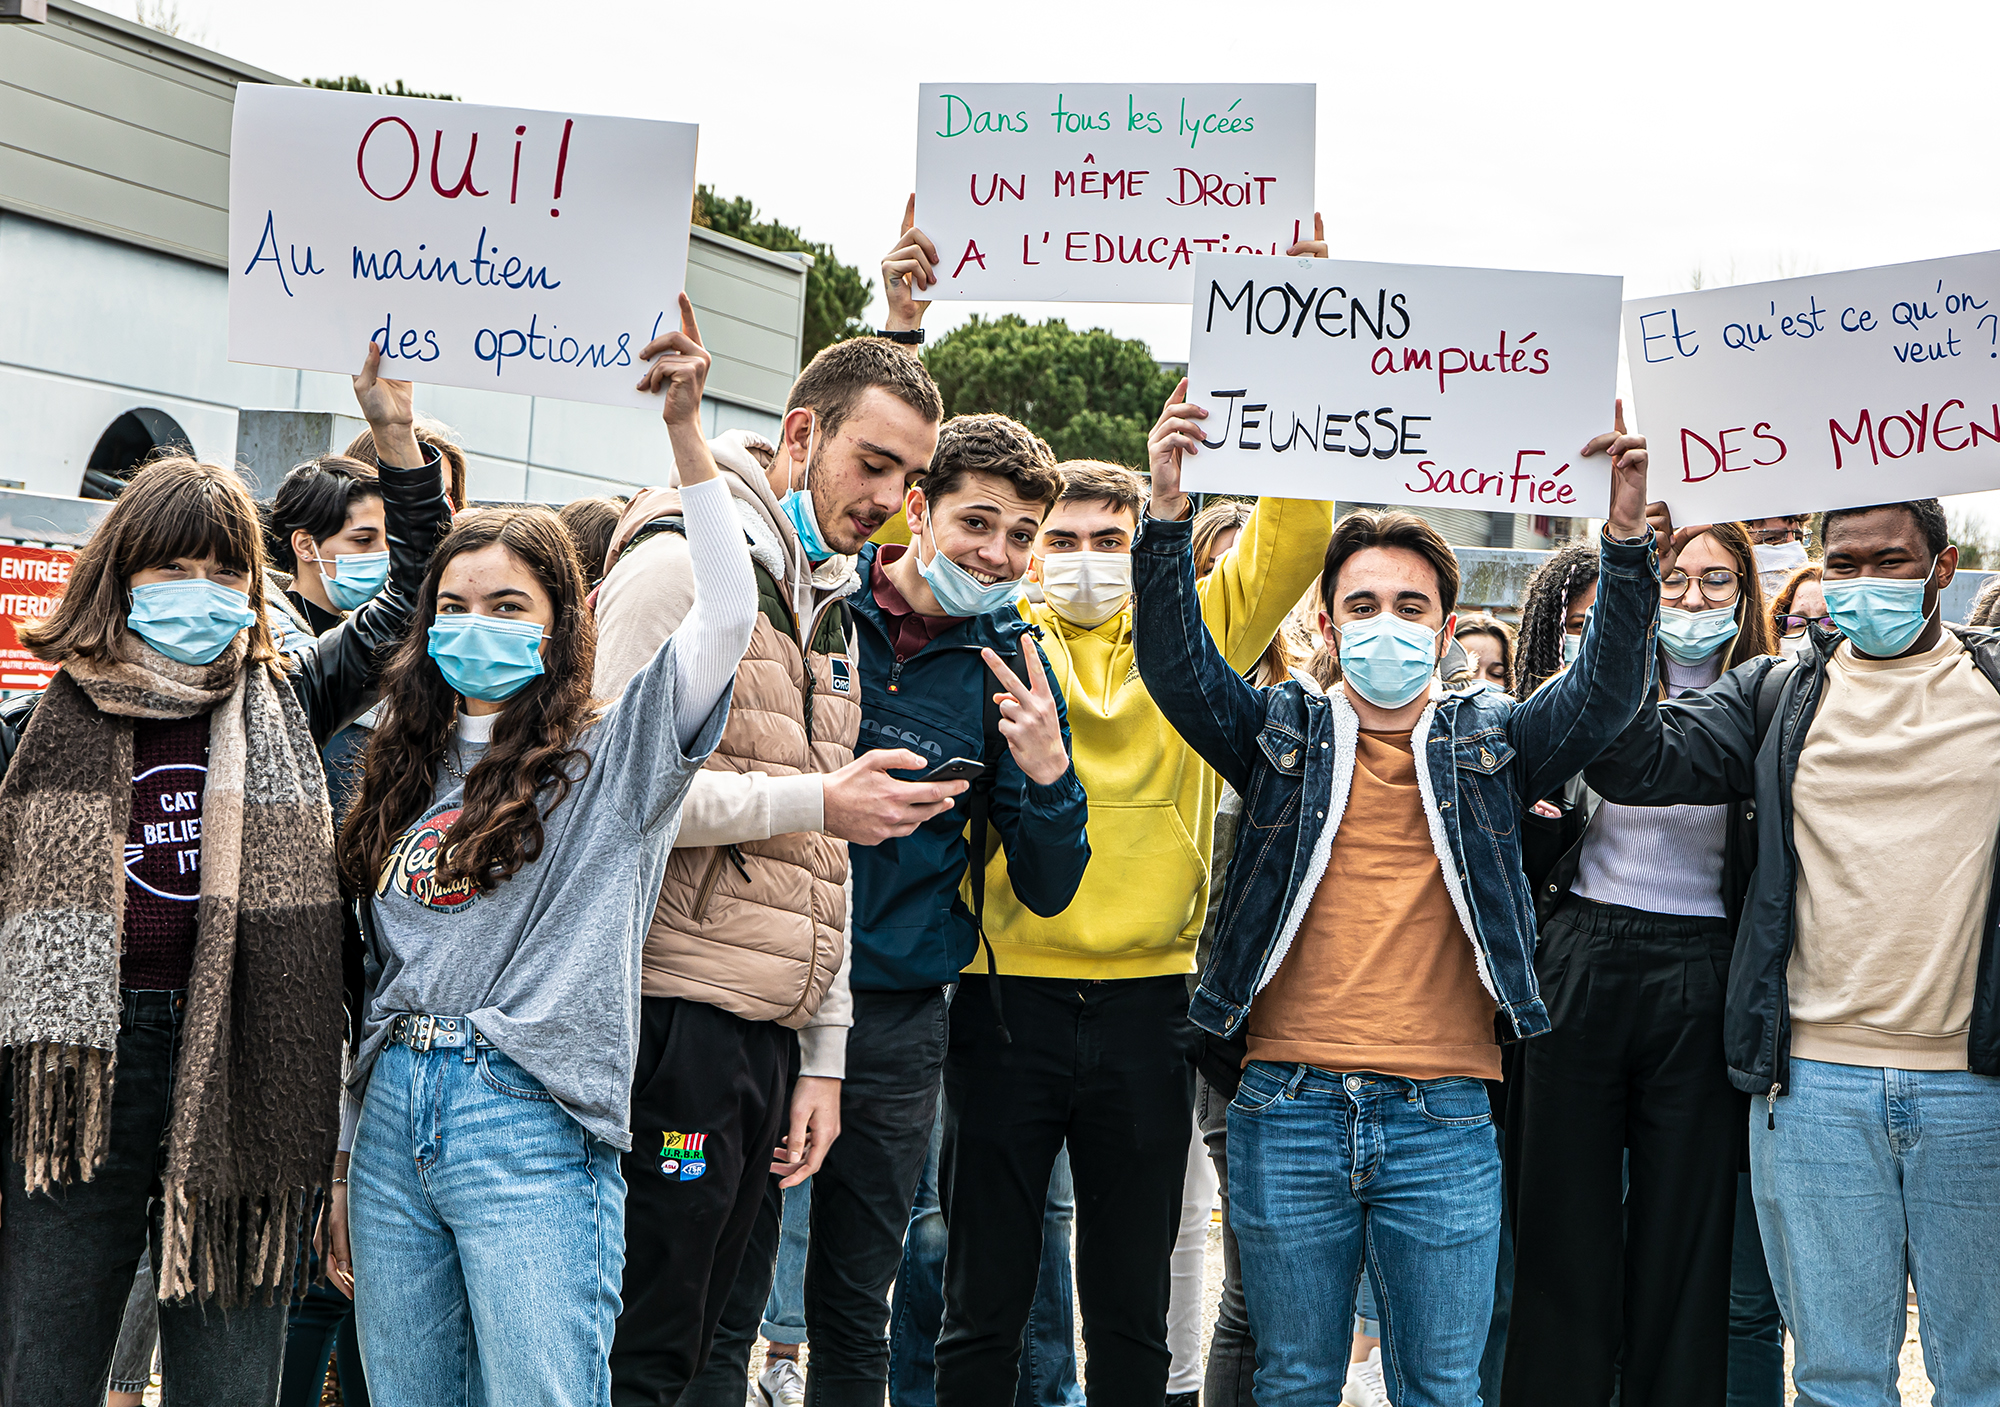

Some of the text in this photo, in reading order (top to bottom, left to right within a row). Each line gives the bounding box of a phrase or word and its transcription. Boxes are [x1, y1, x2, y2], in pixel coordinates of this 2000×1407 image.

[936, 94, 1254, 148] Dans tous les lycées
[970, 174, 1025, 206] UN
[1055, 153, 1149, 200] MÊME
[245, 210, 560, 296] Au maintien
[952, 239, 986, 278] A
[1206, 280, 1410, 340] MOYENS
[1640, 308, 1699, 363] Et
[1841, 307, 1878, 332] ce
[370, 313, 440, 361] des
[1371, 330, 1549, 394] amputés
[1893, 327, 1961, 363] veut
[1200, 389, 1432, 460] JEUNESSE
[1680, 422, 1787, 483] DES
[1, 557, 70, 583] ENTRÉE
[160, 791, 197, 813] CAT
[178, 849, 199, 875] IT
[663, 1148, 703, 1159] U.R.B.R.
